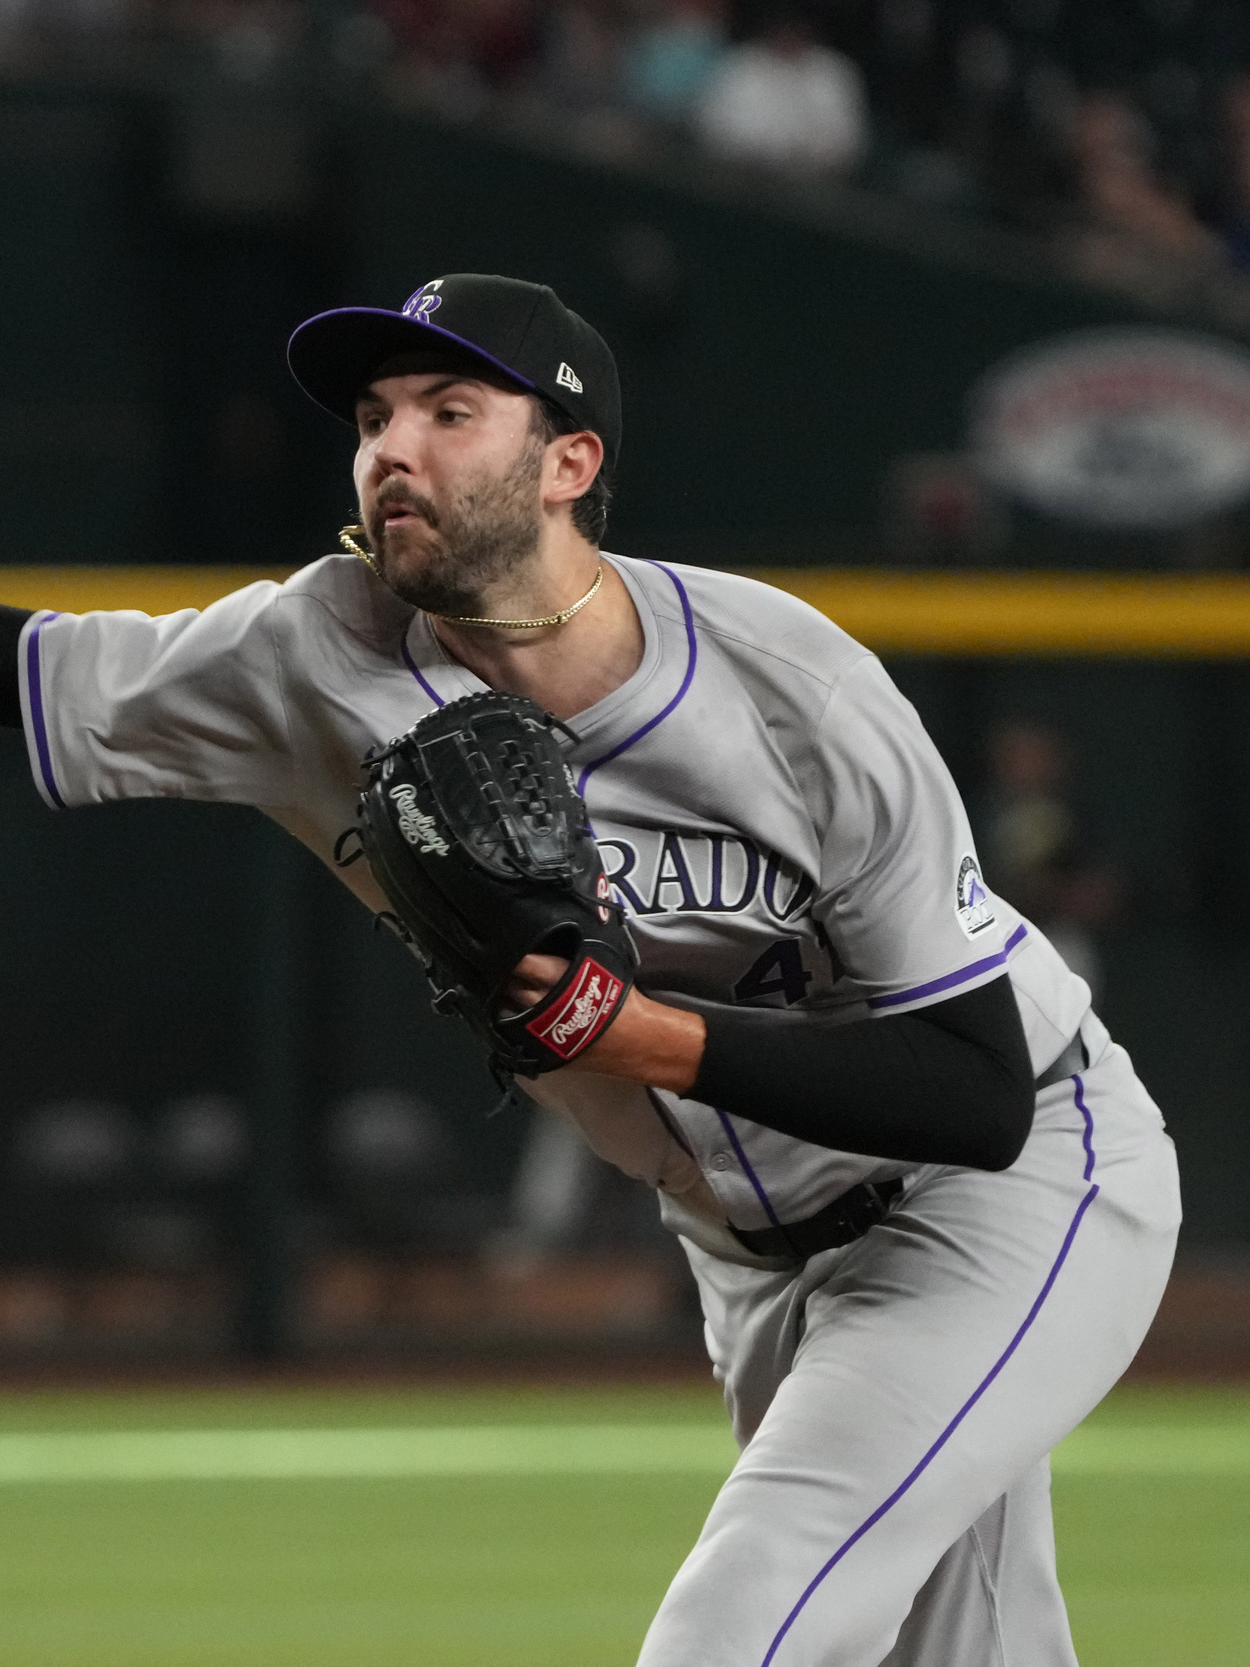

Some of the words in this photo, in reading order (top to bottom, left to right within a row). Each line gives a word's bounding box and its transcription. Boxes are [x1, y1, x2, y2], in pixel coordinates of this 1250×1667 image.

[389, 783, 450, 857] Rawlings
[734, 924, 840, 1005] 4
[551, 974, 602, 1044] Rawlings
